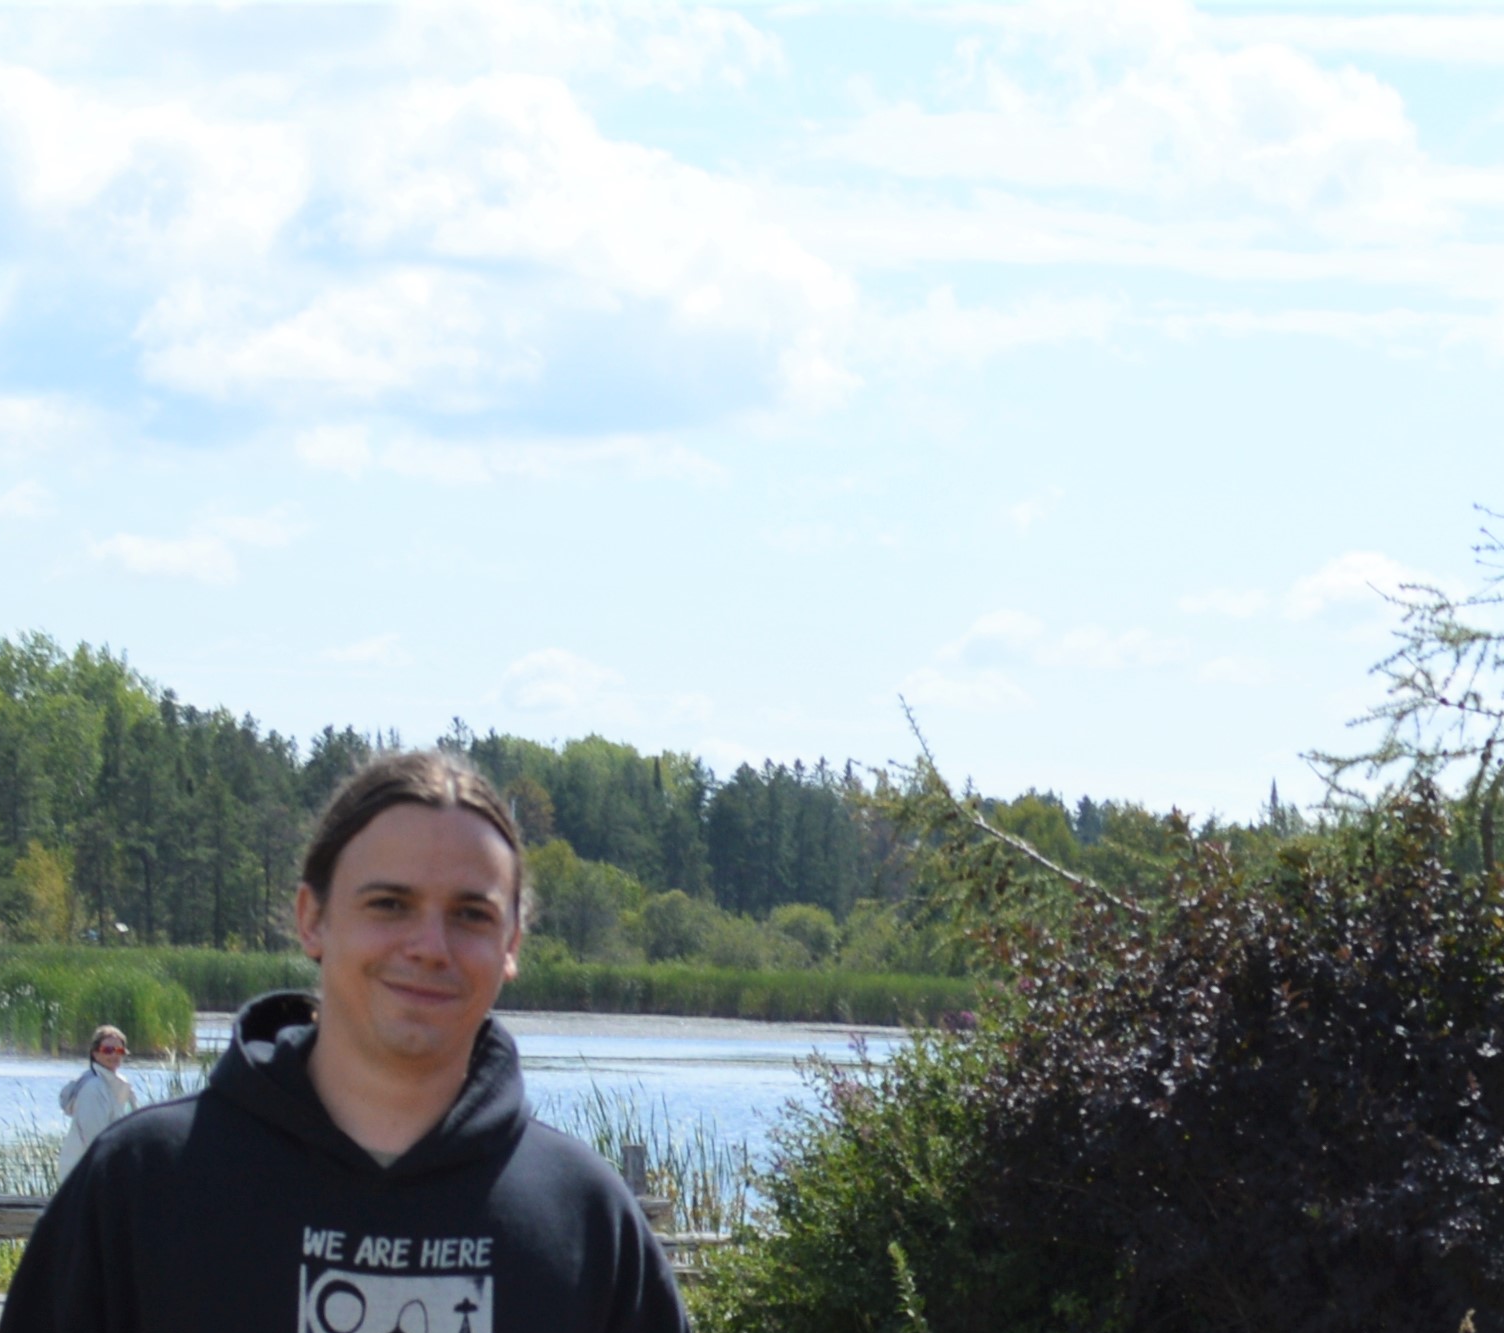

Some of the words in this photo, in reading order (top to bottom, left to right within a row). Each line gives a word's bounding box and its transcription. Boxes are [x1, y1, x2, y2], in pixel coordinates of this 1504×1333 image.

[303, 1226, 346, 1261] WE
[354, 1236, 412, 1268] ARE
[420, 1237, 494, 1268] HERE
